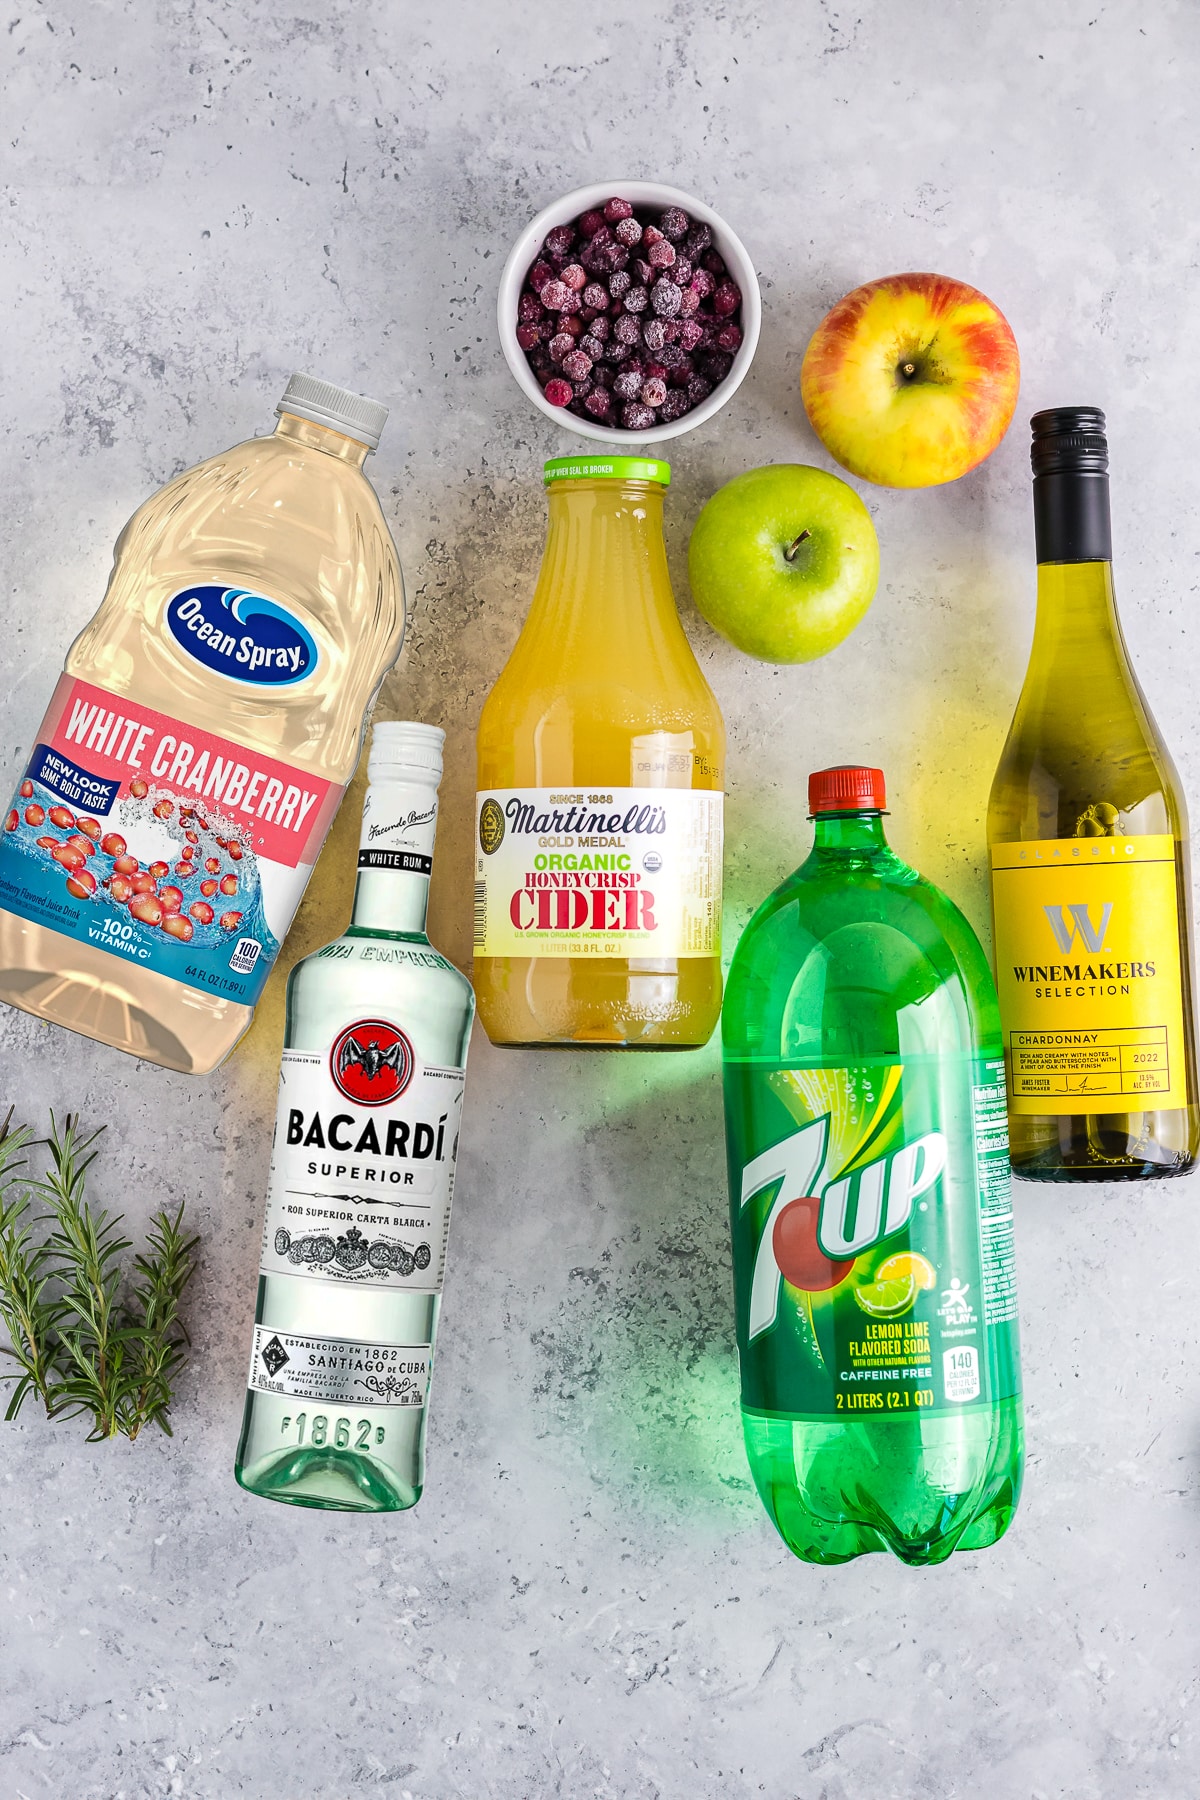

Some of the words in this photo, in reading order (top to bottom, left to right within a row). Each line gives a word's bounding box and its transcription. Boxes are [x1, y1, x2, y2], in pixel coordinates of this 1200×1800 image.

[569, 465, 582, 475] SEAL
[583, 465, 588, 474] IS
[590, 464, 614, 474] BROKEN
[177, 597, 236, 656] Ocean
[64, 697, 154, 769] WHITE
[150, 735, 318, 833] CRANBERRY
[694, 755, 707, 765] BY:
[45, 753, 74, 778] NEW
[73, 771, 113, 797] LOOK
[40, 765, 61, 787] SAME
[60, 778, 81, 800] BOLD
[81, 791, 108, 810] TASTE
[549, 794, 584, 805] SINCE
[587, 794, 613, 805] 1868
[505, 797, 667, 836] Martinelli's
[538, 836, 574, 848] GOLD
[578, 836, 625, 848] MEDAL
[369, 853, 400, 866] WHITE
[403, 856, 422, 869] RUM
[1019, 844, 1135, 860] CLASSIC
[534, 853, 631, 871] ORGANIC
[525, 872, 642, 888] HONEYCRISP
[20, 888, 47, 905] Flavored
[46, 899, 63, 913] Juice
[63, 905, 80, 920] Drink
[510, 889, 658, 931] CIDER
[103, 918, 142, 943] 100%
[582, 931, 627, 939] HONEYCRISP
[1042, 902, 1114, 955] W
[88, 928, 137, 954] VITAMIN
[239, 941, 258, 959] 100
[546, 943, 567, 952] LITER
[569, 943, 589, 953] (33.8
[590, 943, 603, 952] FL.
[232, 954, 255, 966] CALORIES
[185, 965, 198, 977] 64
[197, 970, 207, 981] FL
[208, 974, 220, 986] OZ
[219, 978, 240, 992] (1.89
[239, 984, 247, 996] L)
[1013, 961, 1156, 983] WINEMAKERS
[1035, 985, 1130, 998] SELECTION
[1018, 1034, 1098, 1045] CHARDONNAY
[1133, 1053, 1159, 1063] 2022
[287, 1109, 448, 1161] BACARDÍ
[308, 1162, 414, 1184] SUPERIOR
[288, 1204, 303, 1215] RON
[306, 1208, 353, 1221] SUPERIOR
[357, 1213, 389, 1225] CARTA
[393, 1217, 425, 1228] BLANCA
[937, 1307, 955, 1316] LET'S
[866, 1324, 902, 1339] LEMON
[904, 1321, 930, 1338] LIME
[285, 1338, 344, 1353] ESTABLECIDO
[365, 1349, 398, 1361] 1862
[849, 1340, 901, 1356] FLAVORED
[904, 1338, 931, 1354] SODA
[308, 1354, 384, 1373] SANTIAGO
[387, 1366, 397, 1374] DE
[399, 1362, 425, 1374] CUBA
[853, 1359, 866, 1367] WITH
[867, 1358, 885, 1367] OTHER
[885, 1357, 908, 1365] NATURAL
[950, 1352, 972, 1370] 140
[288, 1375, 312, 1384] FAMILIA
[297, 1371, 327, 1380] EMPRESA
[840, 1370, 900, 1381] CAFFEINE
[902, 1367, 932, 1379] FREE
[949, 1369, 974, 1379] CALORIES
[947, 1380, 957, 1389] PER
[964, 1379, 971, 1387] FL
[951, 1386, 974, 1397] SERVING
[326, 1393, 354, 1401] PUERTO
[836, 1393, 844, 1409] 2
[847, 1393, 884, 1408] LITERS
[887, 1391, 910, 1409] (2.1
[914, 1389, 934, 1407] QT)
[296, 1412, 372, 1453] 1862
